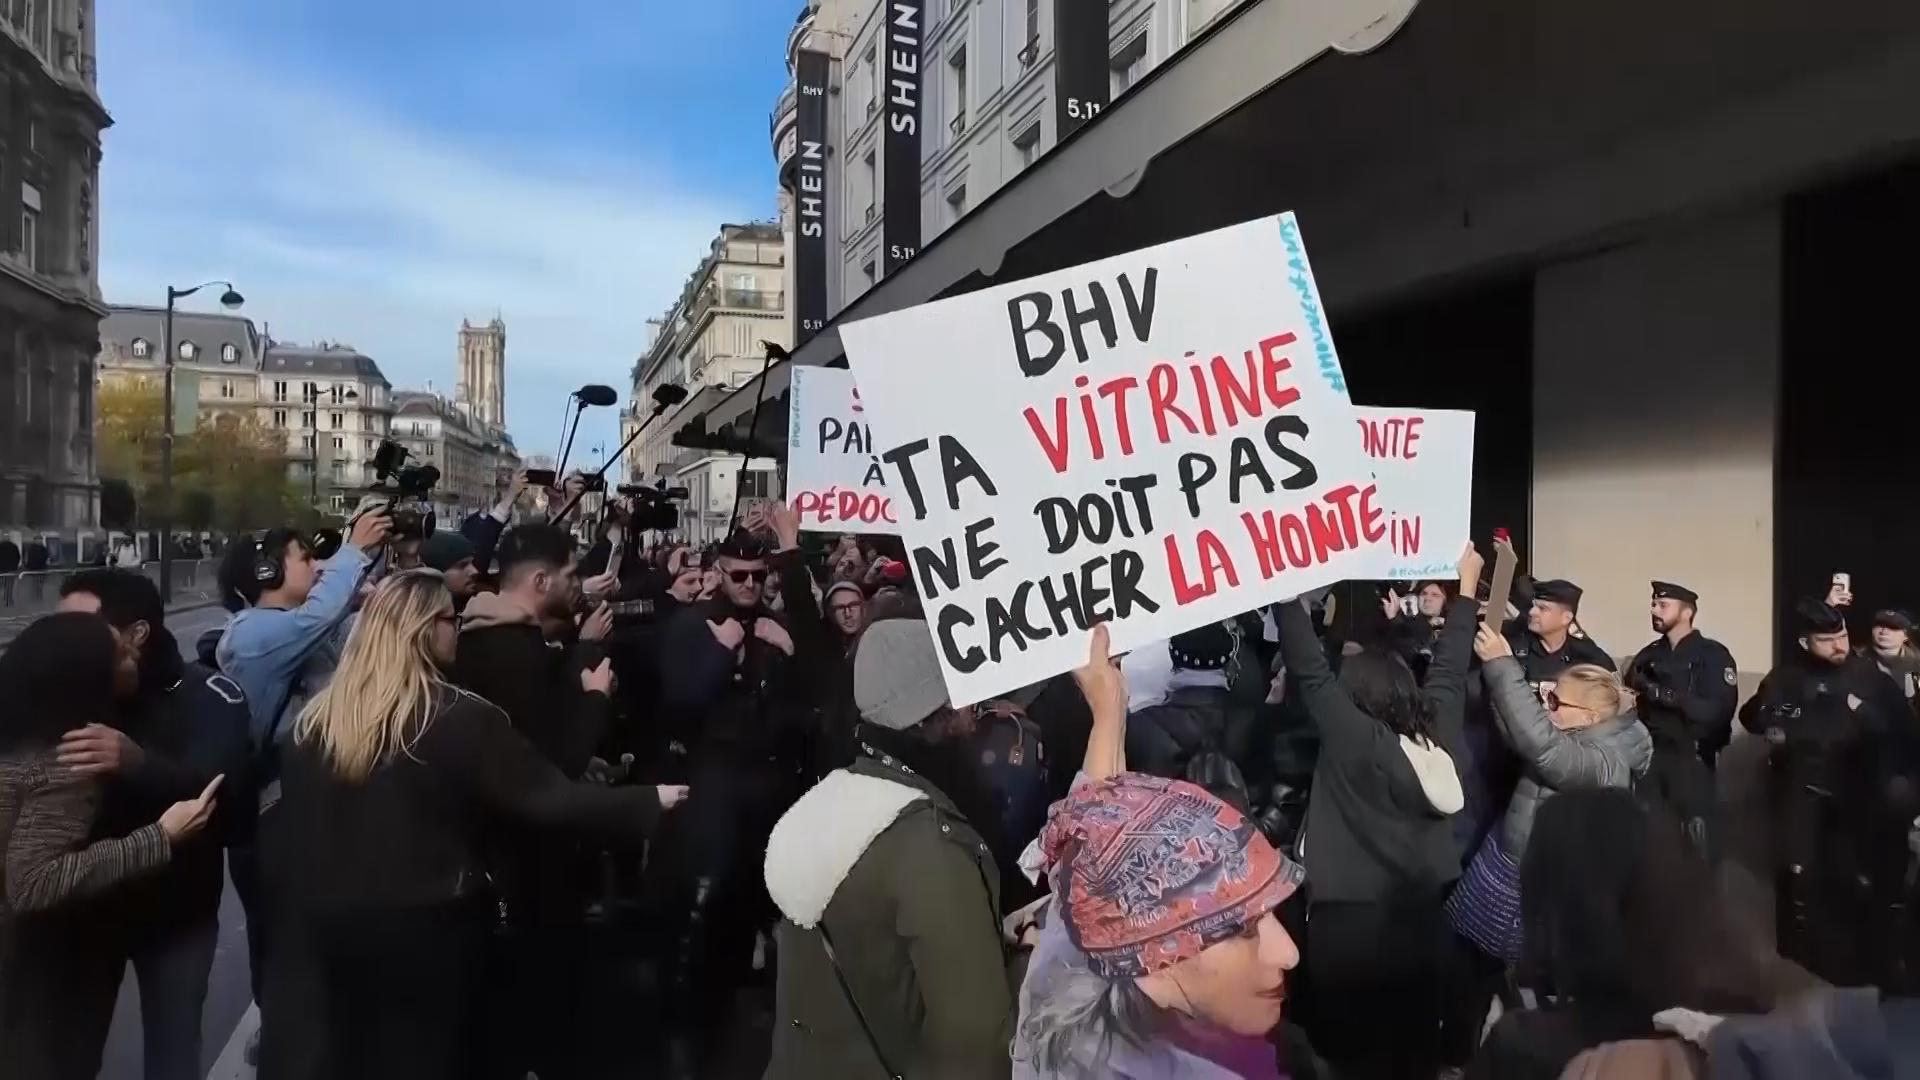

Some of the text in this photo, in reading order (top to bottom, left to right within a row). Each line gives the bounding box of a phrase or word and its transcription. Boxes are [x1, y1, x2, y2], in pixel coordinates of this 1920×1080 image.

[802, 85, 825, 96] BHV
[891, 3, 919, 136] SHEIN
[801, 140, 823, 238] SHEIN
[1007, 268, 1158, 377] BHV
[863, 455, 886, 487] À
[882, 435, 998, 520] TA
[913, 517, 1008, 599] NE
[1178, 416, 1317, 517] PAS
[937, 484, 1386, 673] CACHER LA HONTE
